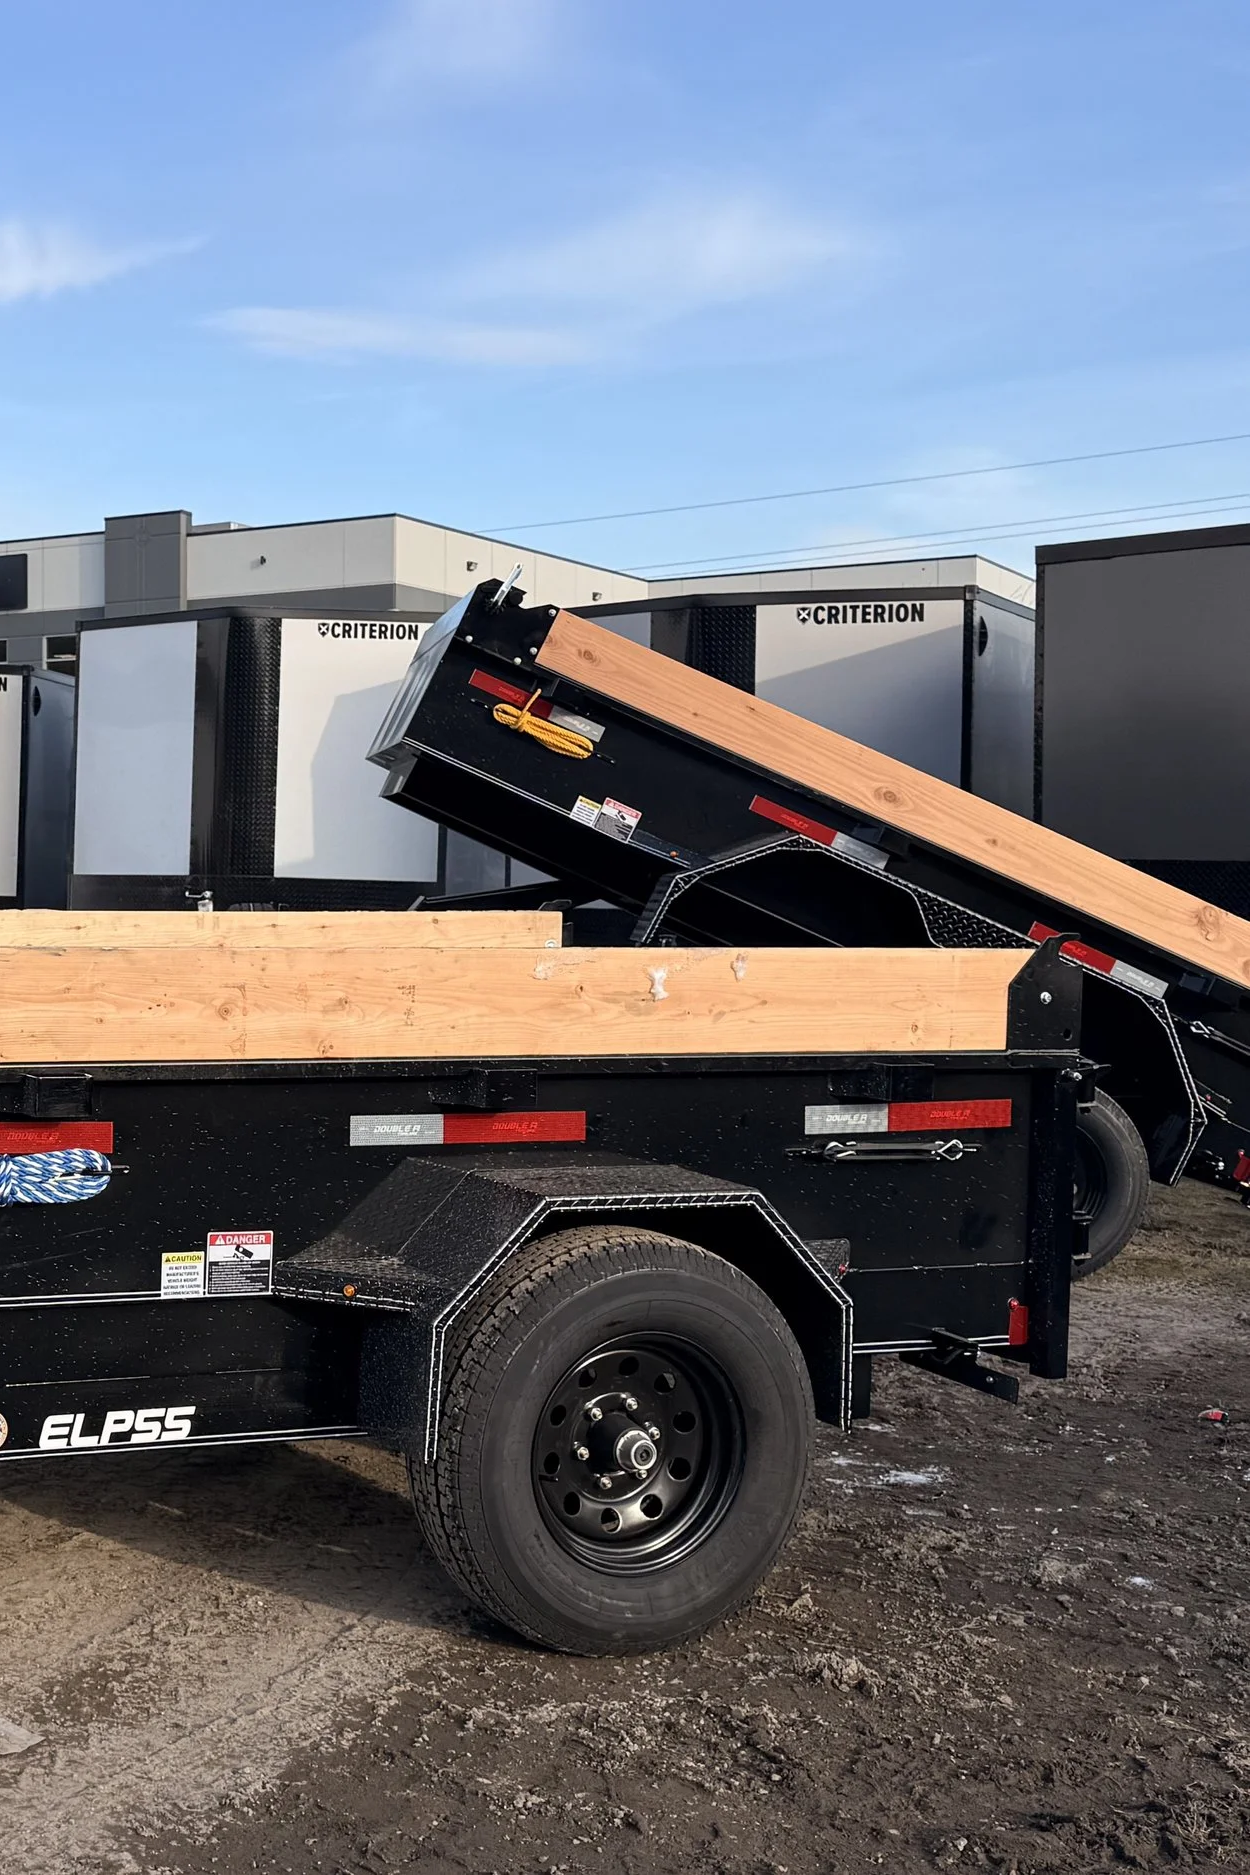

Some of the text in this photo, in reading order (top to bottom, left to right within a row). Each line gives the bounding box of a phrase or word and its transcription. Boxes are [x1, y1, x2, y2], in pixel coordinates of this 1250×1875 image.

[813, 603, 925, 625] CRITERION
[331, 622, 419, 640] CRITERION
[226, 1234, 266, 1245] DANGER
[171, 1255, 203, 1263] CAUTION
